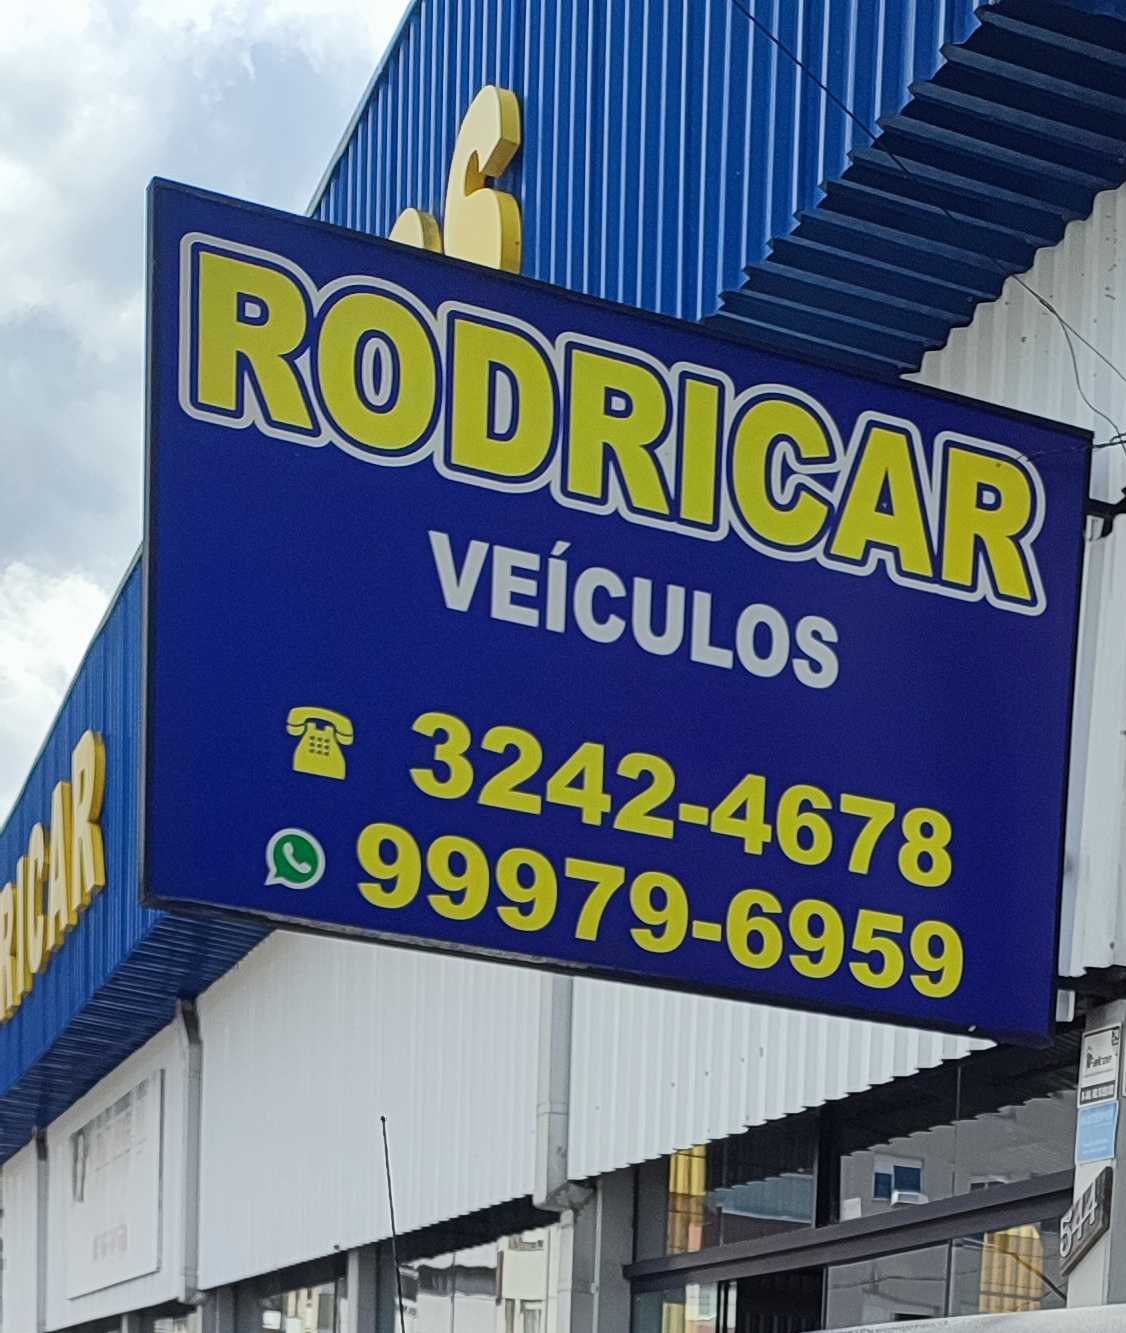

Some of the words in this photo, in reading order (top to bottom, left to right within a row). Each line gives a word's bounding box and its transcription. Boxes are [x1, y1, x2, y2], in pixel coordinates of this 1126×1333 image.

[180, 232, 1046, 615] RODRICAR
[429, 531, 839, 689] VEÍCULOS
[409, 711, 953, 887] 3242-4678
[356, 822, 964, 998] 99979-6959
[1060, 1181, 1097, 1257] 544
